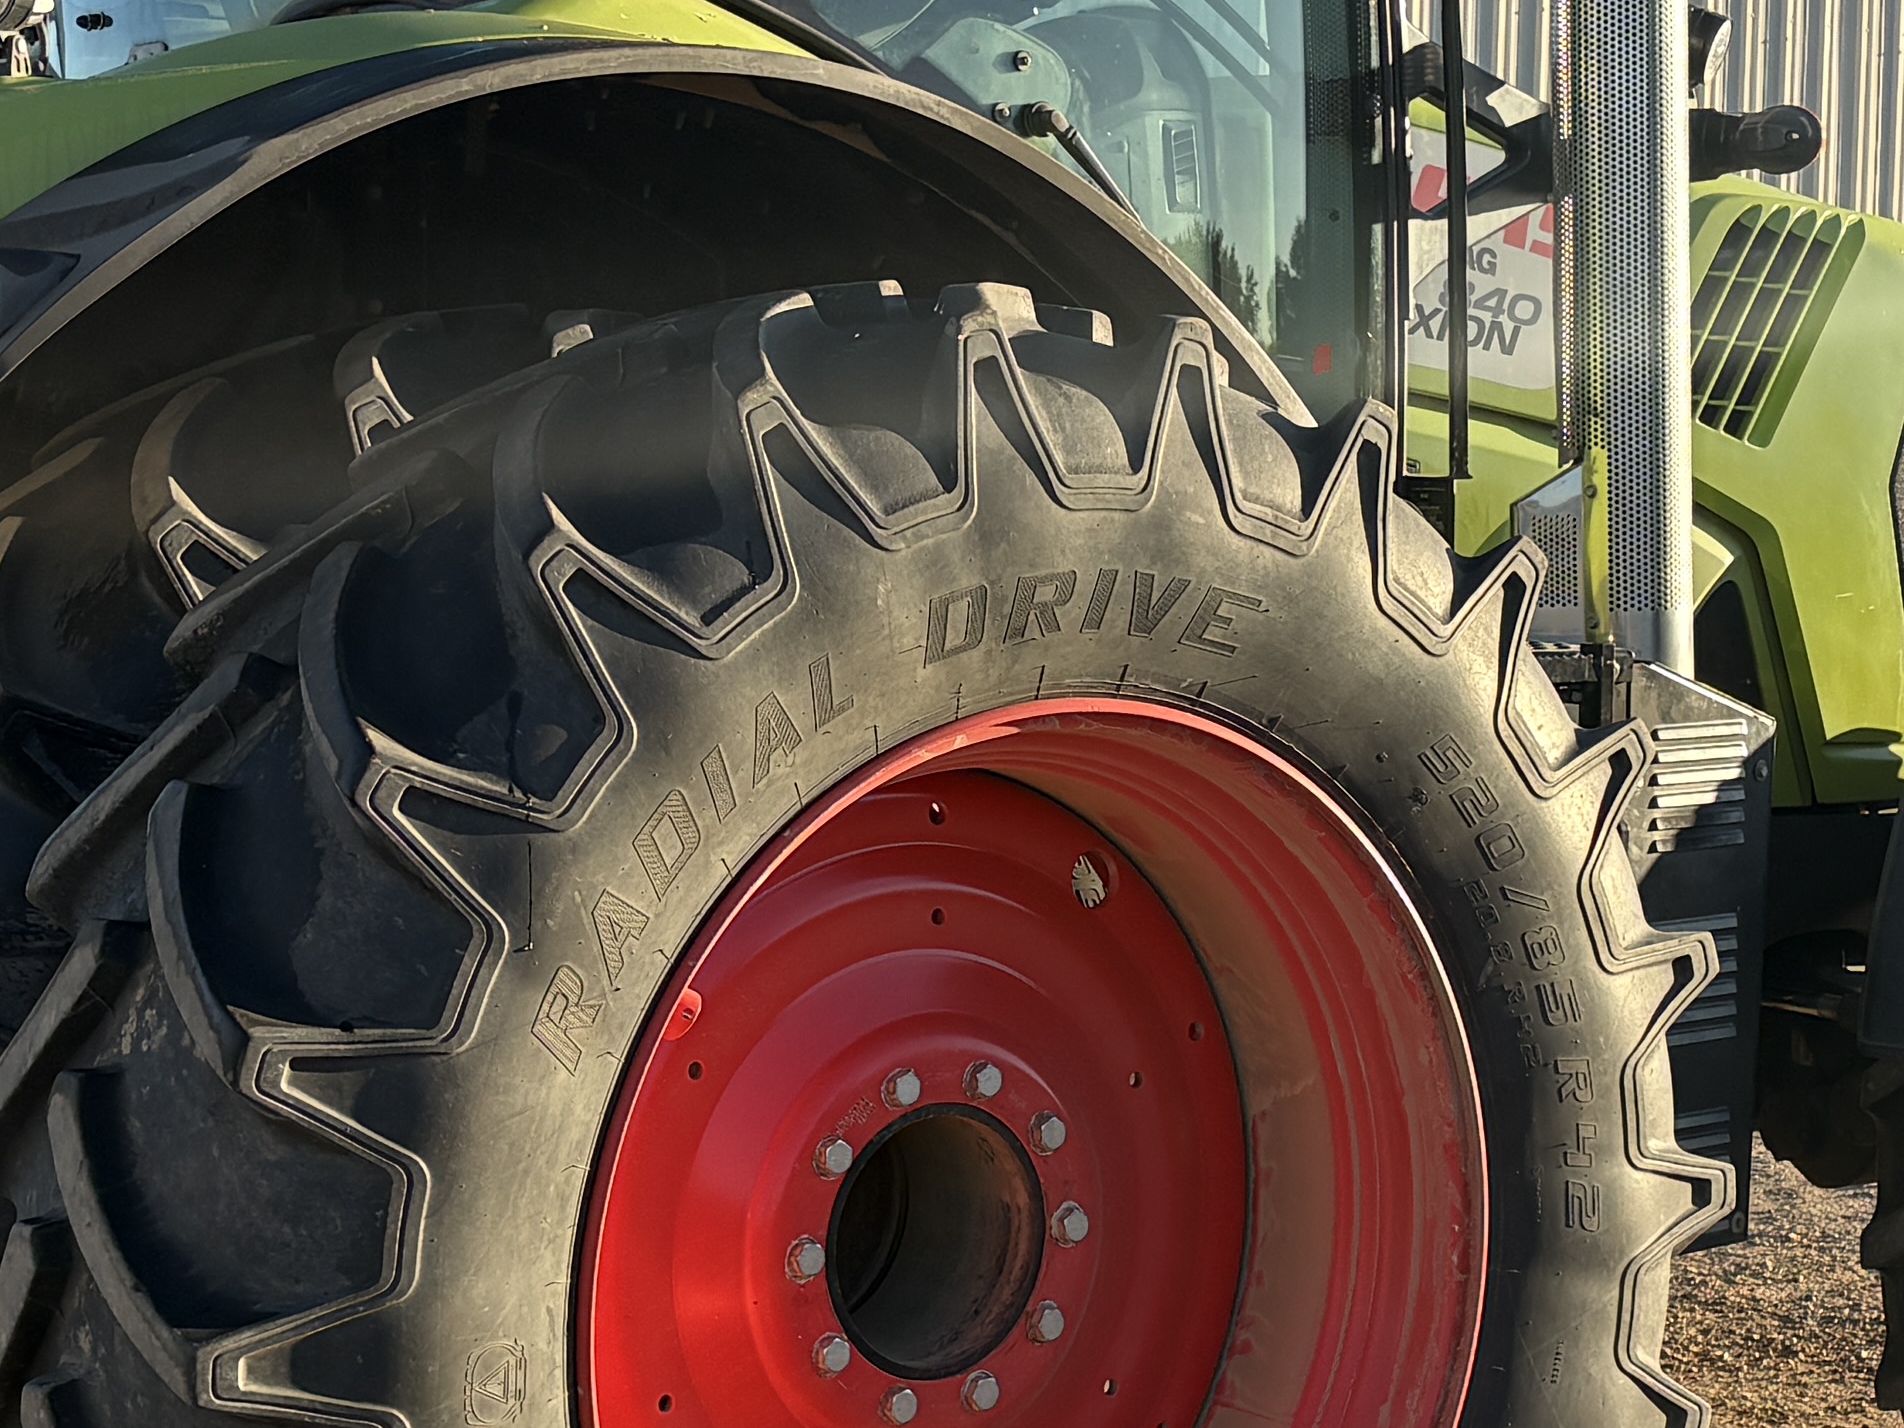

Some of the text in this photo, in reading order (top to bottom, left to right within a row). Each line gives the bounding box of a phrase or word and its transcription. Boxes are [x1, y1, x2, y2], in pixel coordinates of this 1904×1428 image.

[531, 568, 1264, 1077] RADIAL DRIVE
[1417, 733, 1582, 1028] 520/85
